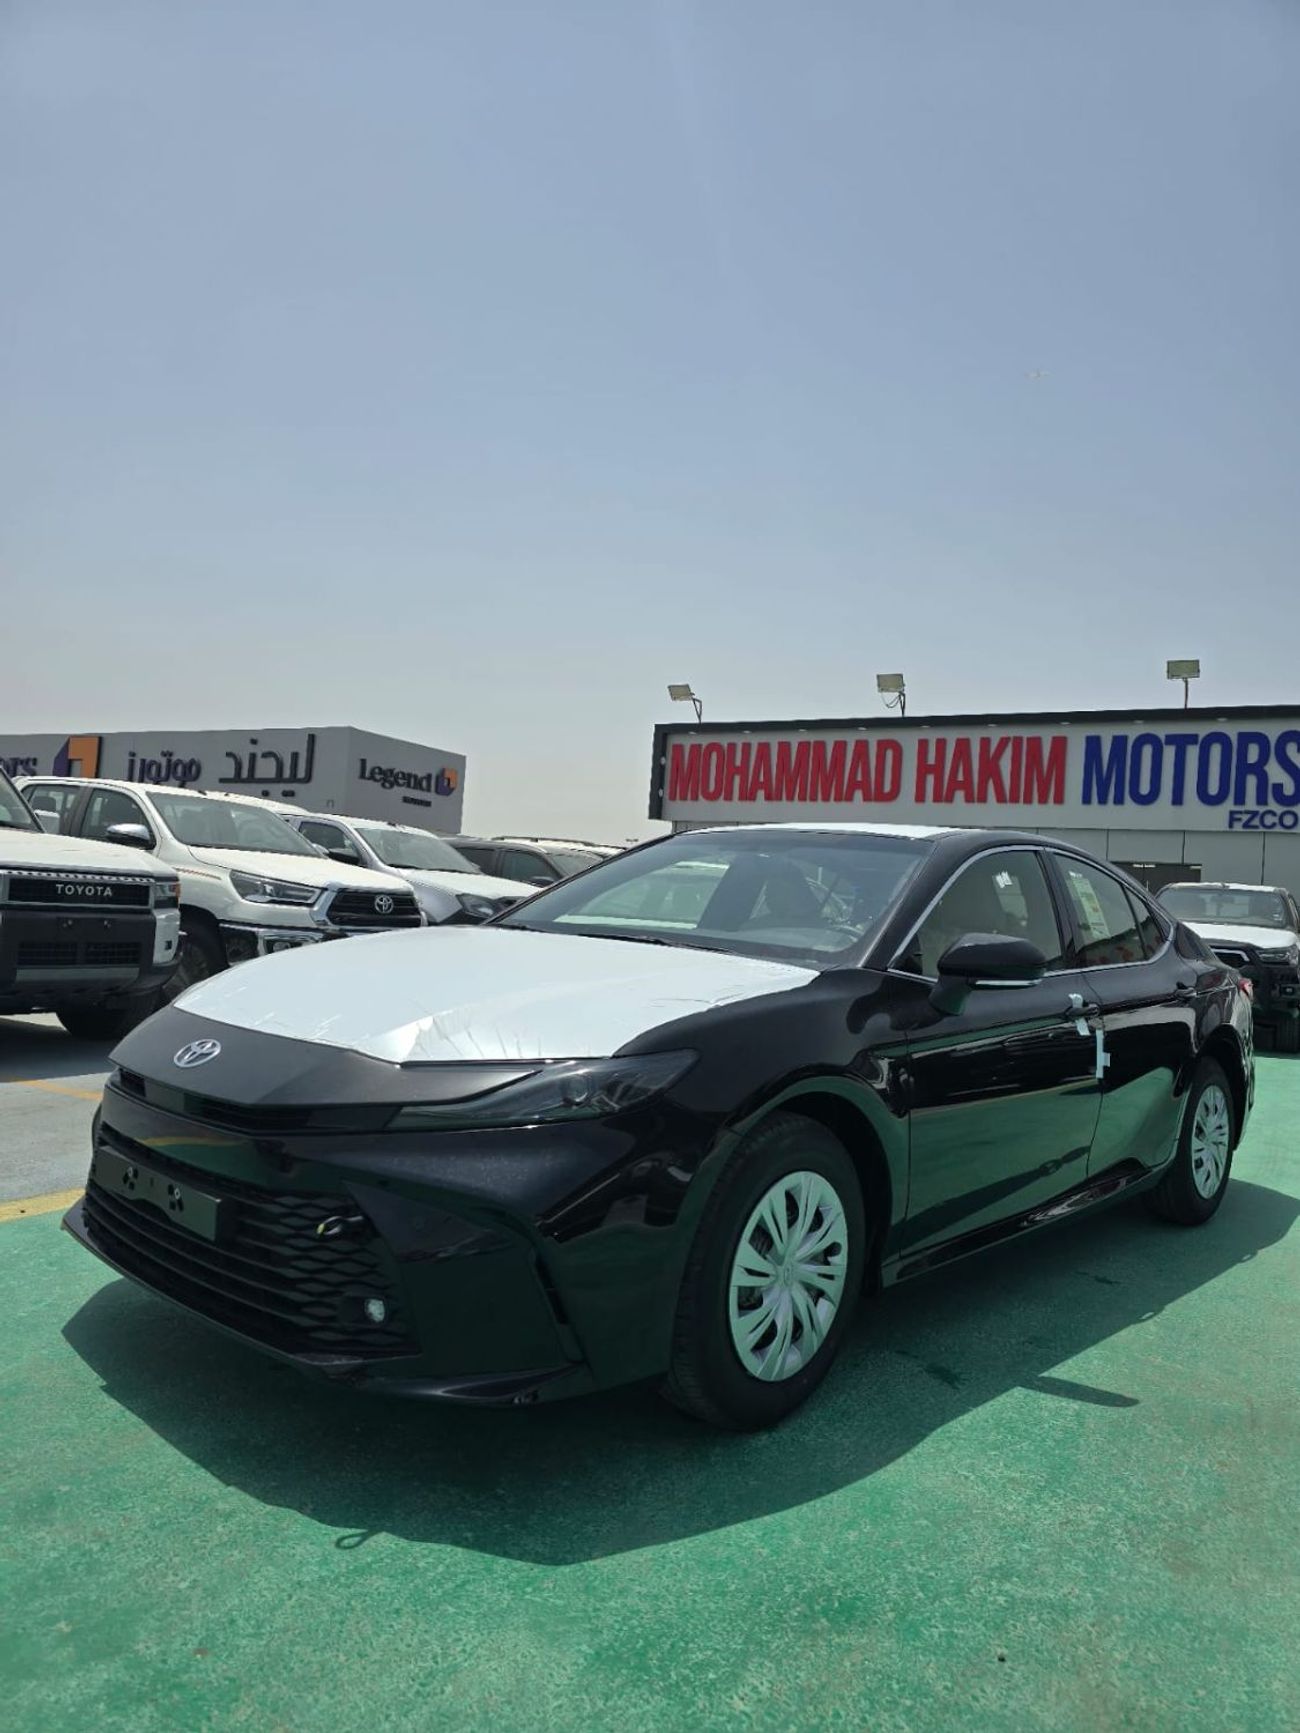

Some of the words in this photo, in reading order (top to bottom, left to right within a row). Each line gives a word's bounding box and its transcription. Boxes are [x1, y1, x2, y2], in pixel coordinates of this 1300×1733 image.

[218, 733, 316, 797] ليجند
[358, 758, 433, 793] Legend
[668, 739, 903, 803] MOHAMMAD
[914, 736, 1068, 805] HAKIM
[1081, 730, 1300, 807] MOTORS
[1228, 810, 1299, 830] FZCO
[55, 883, 113, 897] TOYOTA
